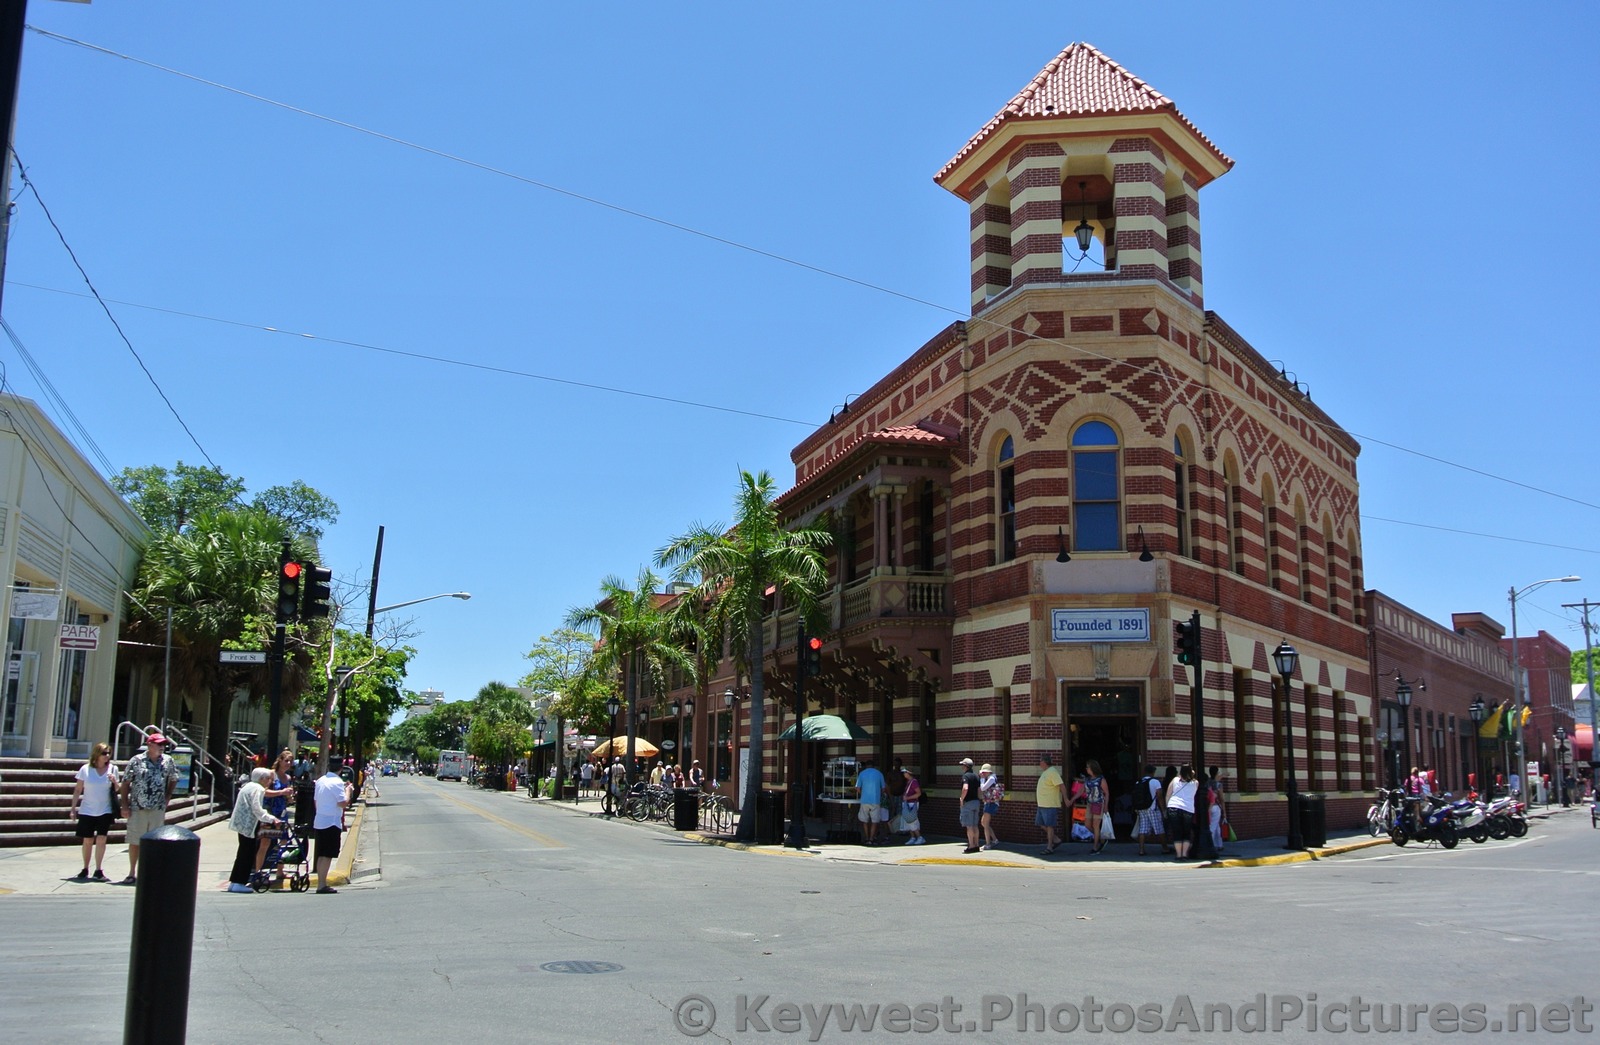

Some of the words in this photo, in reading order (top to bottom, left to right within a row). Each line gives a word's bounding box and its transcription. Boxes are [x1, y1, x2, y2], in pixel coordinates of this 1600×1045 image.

[1059, 619, 1112, 631] Founded
[1118, 618, 1144, 631] 1891
[60, 624, 99, 638] PARK
[229, 653, 248, 661] Front
[442, 754, 463, 763] FedEx
